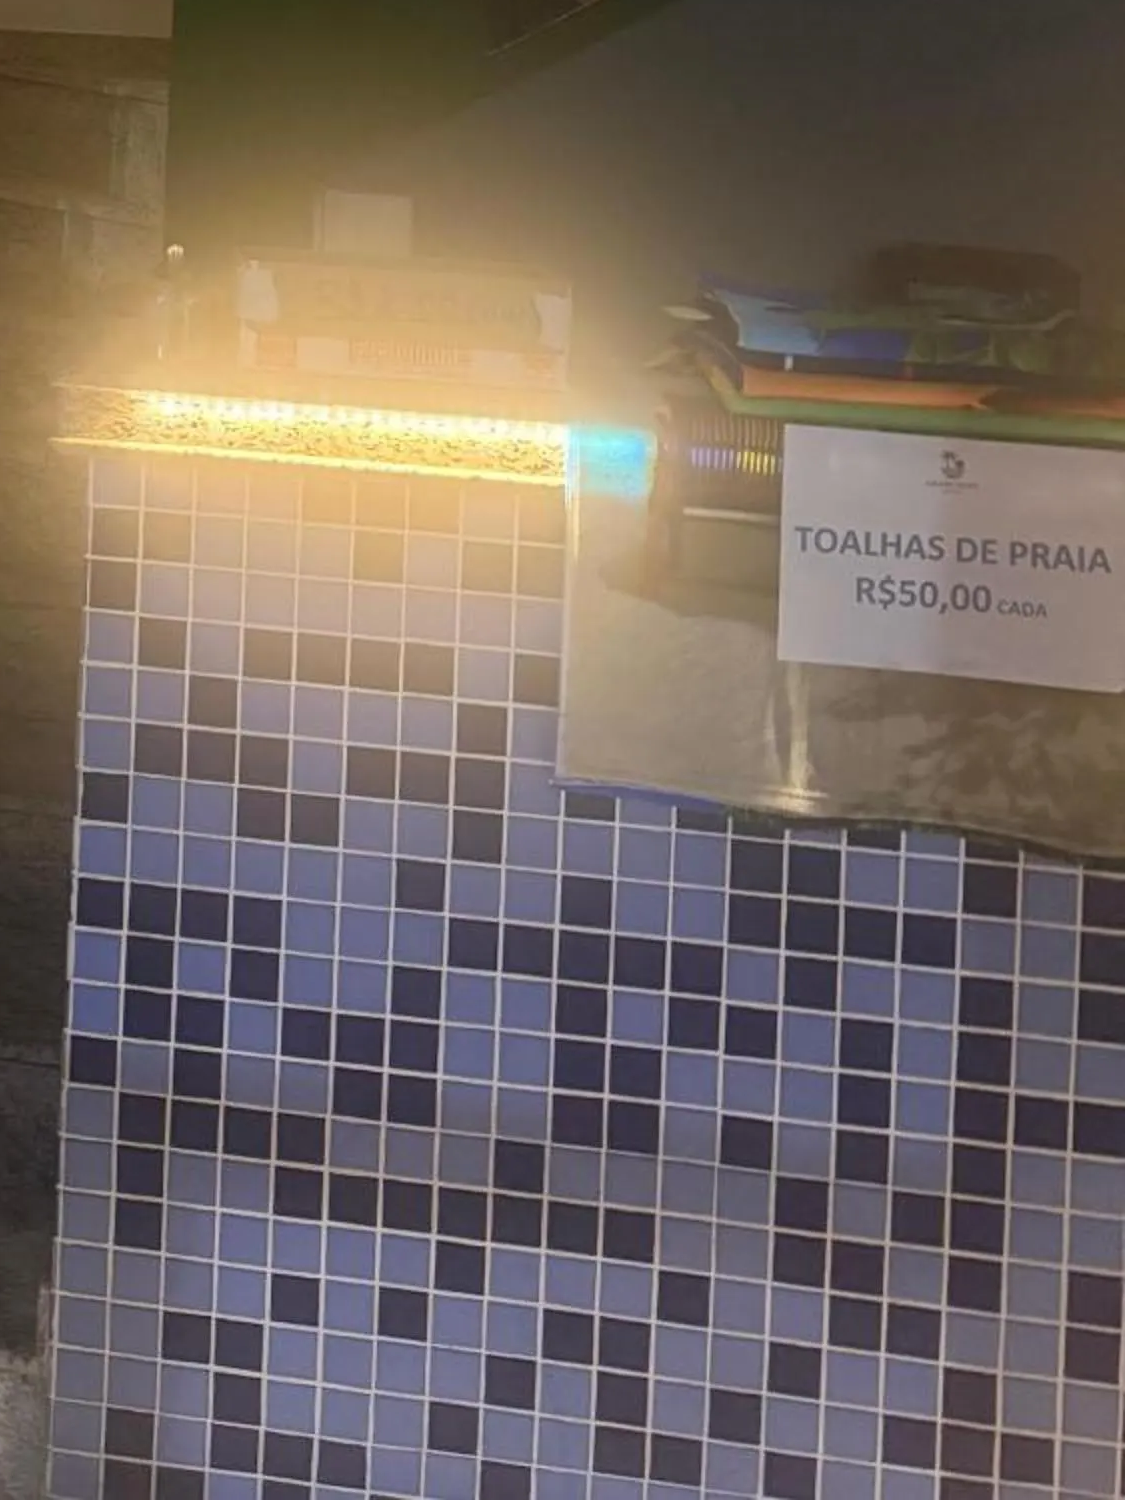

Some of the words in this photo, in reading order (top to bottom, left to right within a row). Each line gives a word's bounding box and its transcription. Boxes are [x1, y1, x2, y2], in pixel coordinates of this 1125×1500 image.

[794, 526, 945, 562] TOALHAS
[956, 537, 999, 565] DE
[1009, 540, 1112, 574] PRAIA
[855, 574, 993, 615] R$50,00
[996, 599, 1048, 619] CADA
